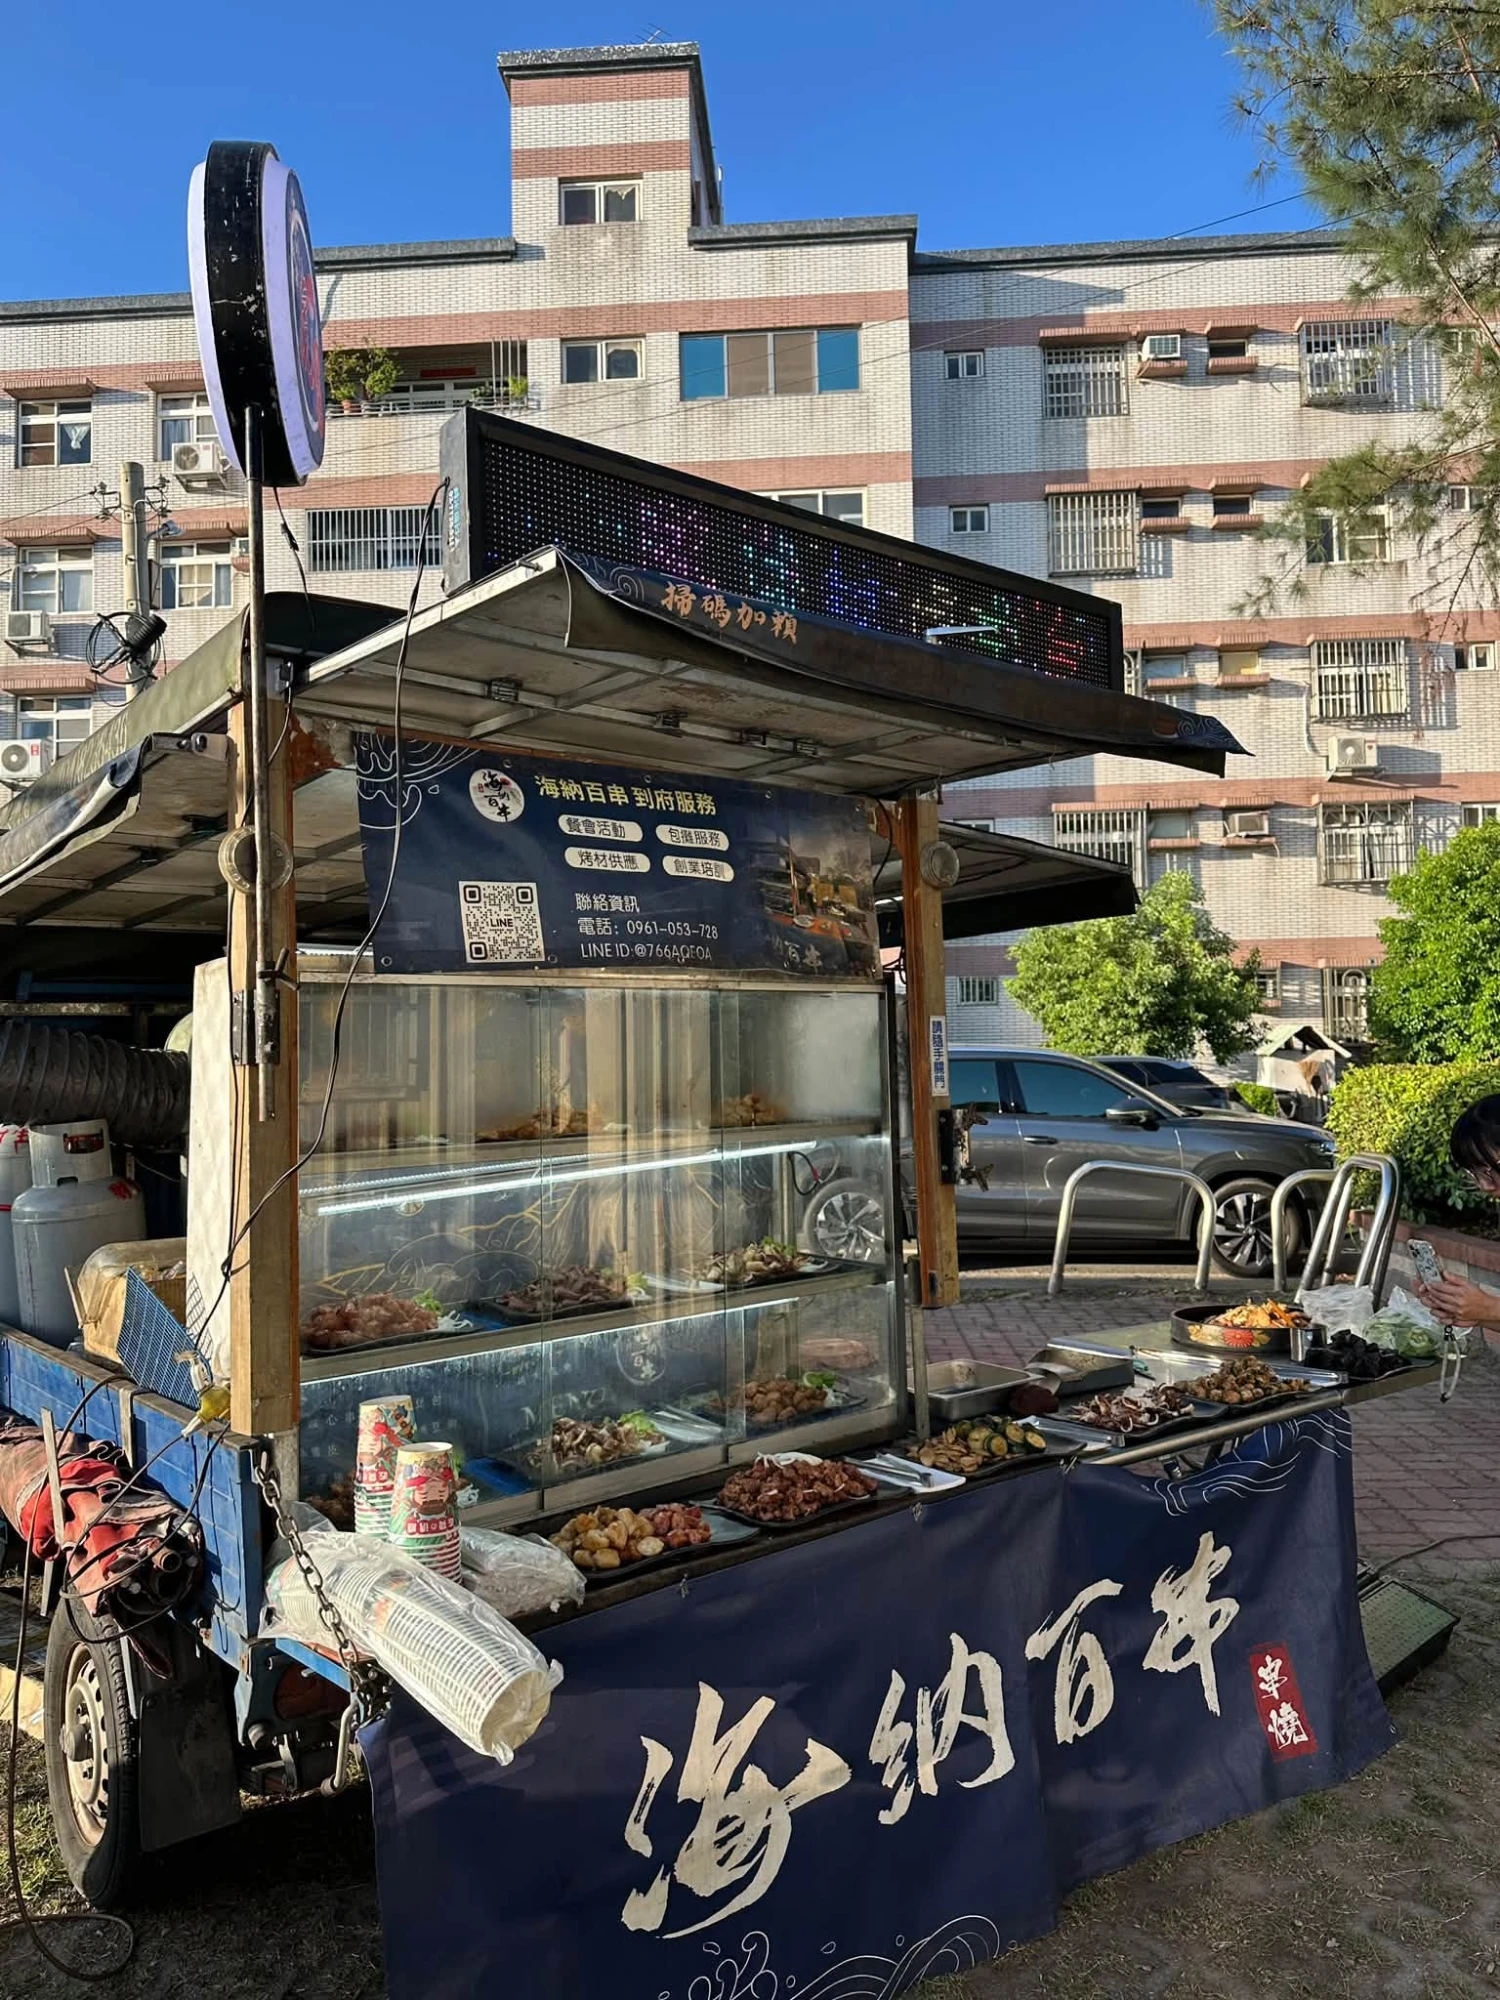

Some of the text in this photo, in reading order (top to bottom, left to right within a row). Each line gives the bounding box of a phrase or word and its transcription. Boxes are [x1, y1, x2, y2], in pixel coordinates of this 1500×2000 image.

[661, 581, 799, 644] 掃碼加賴
[534, 775, 717, 816] 海納百串 到府服務
[566, 817, 626, 839] 餐會活動
[668, 828, 721, 847] 包攤服務
[578, 849, 640, 870] 烤材供應
[674, 858, 726, 879] 創業培訓
[575, 892, 640, 913] 聯絡資訊
[490, 918, 514, 928] LINE
[626, 919, 719, 940] 0961-053-728
[581, 943, 613, 958] LINE
[1257, 1654, 1309, 1750] 串燒
[622, 1531, 1240, 1939] 海納百串
